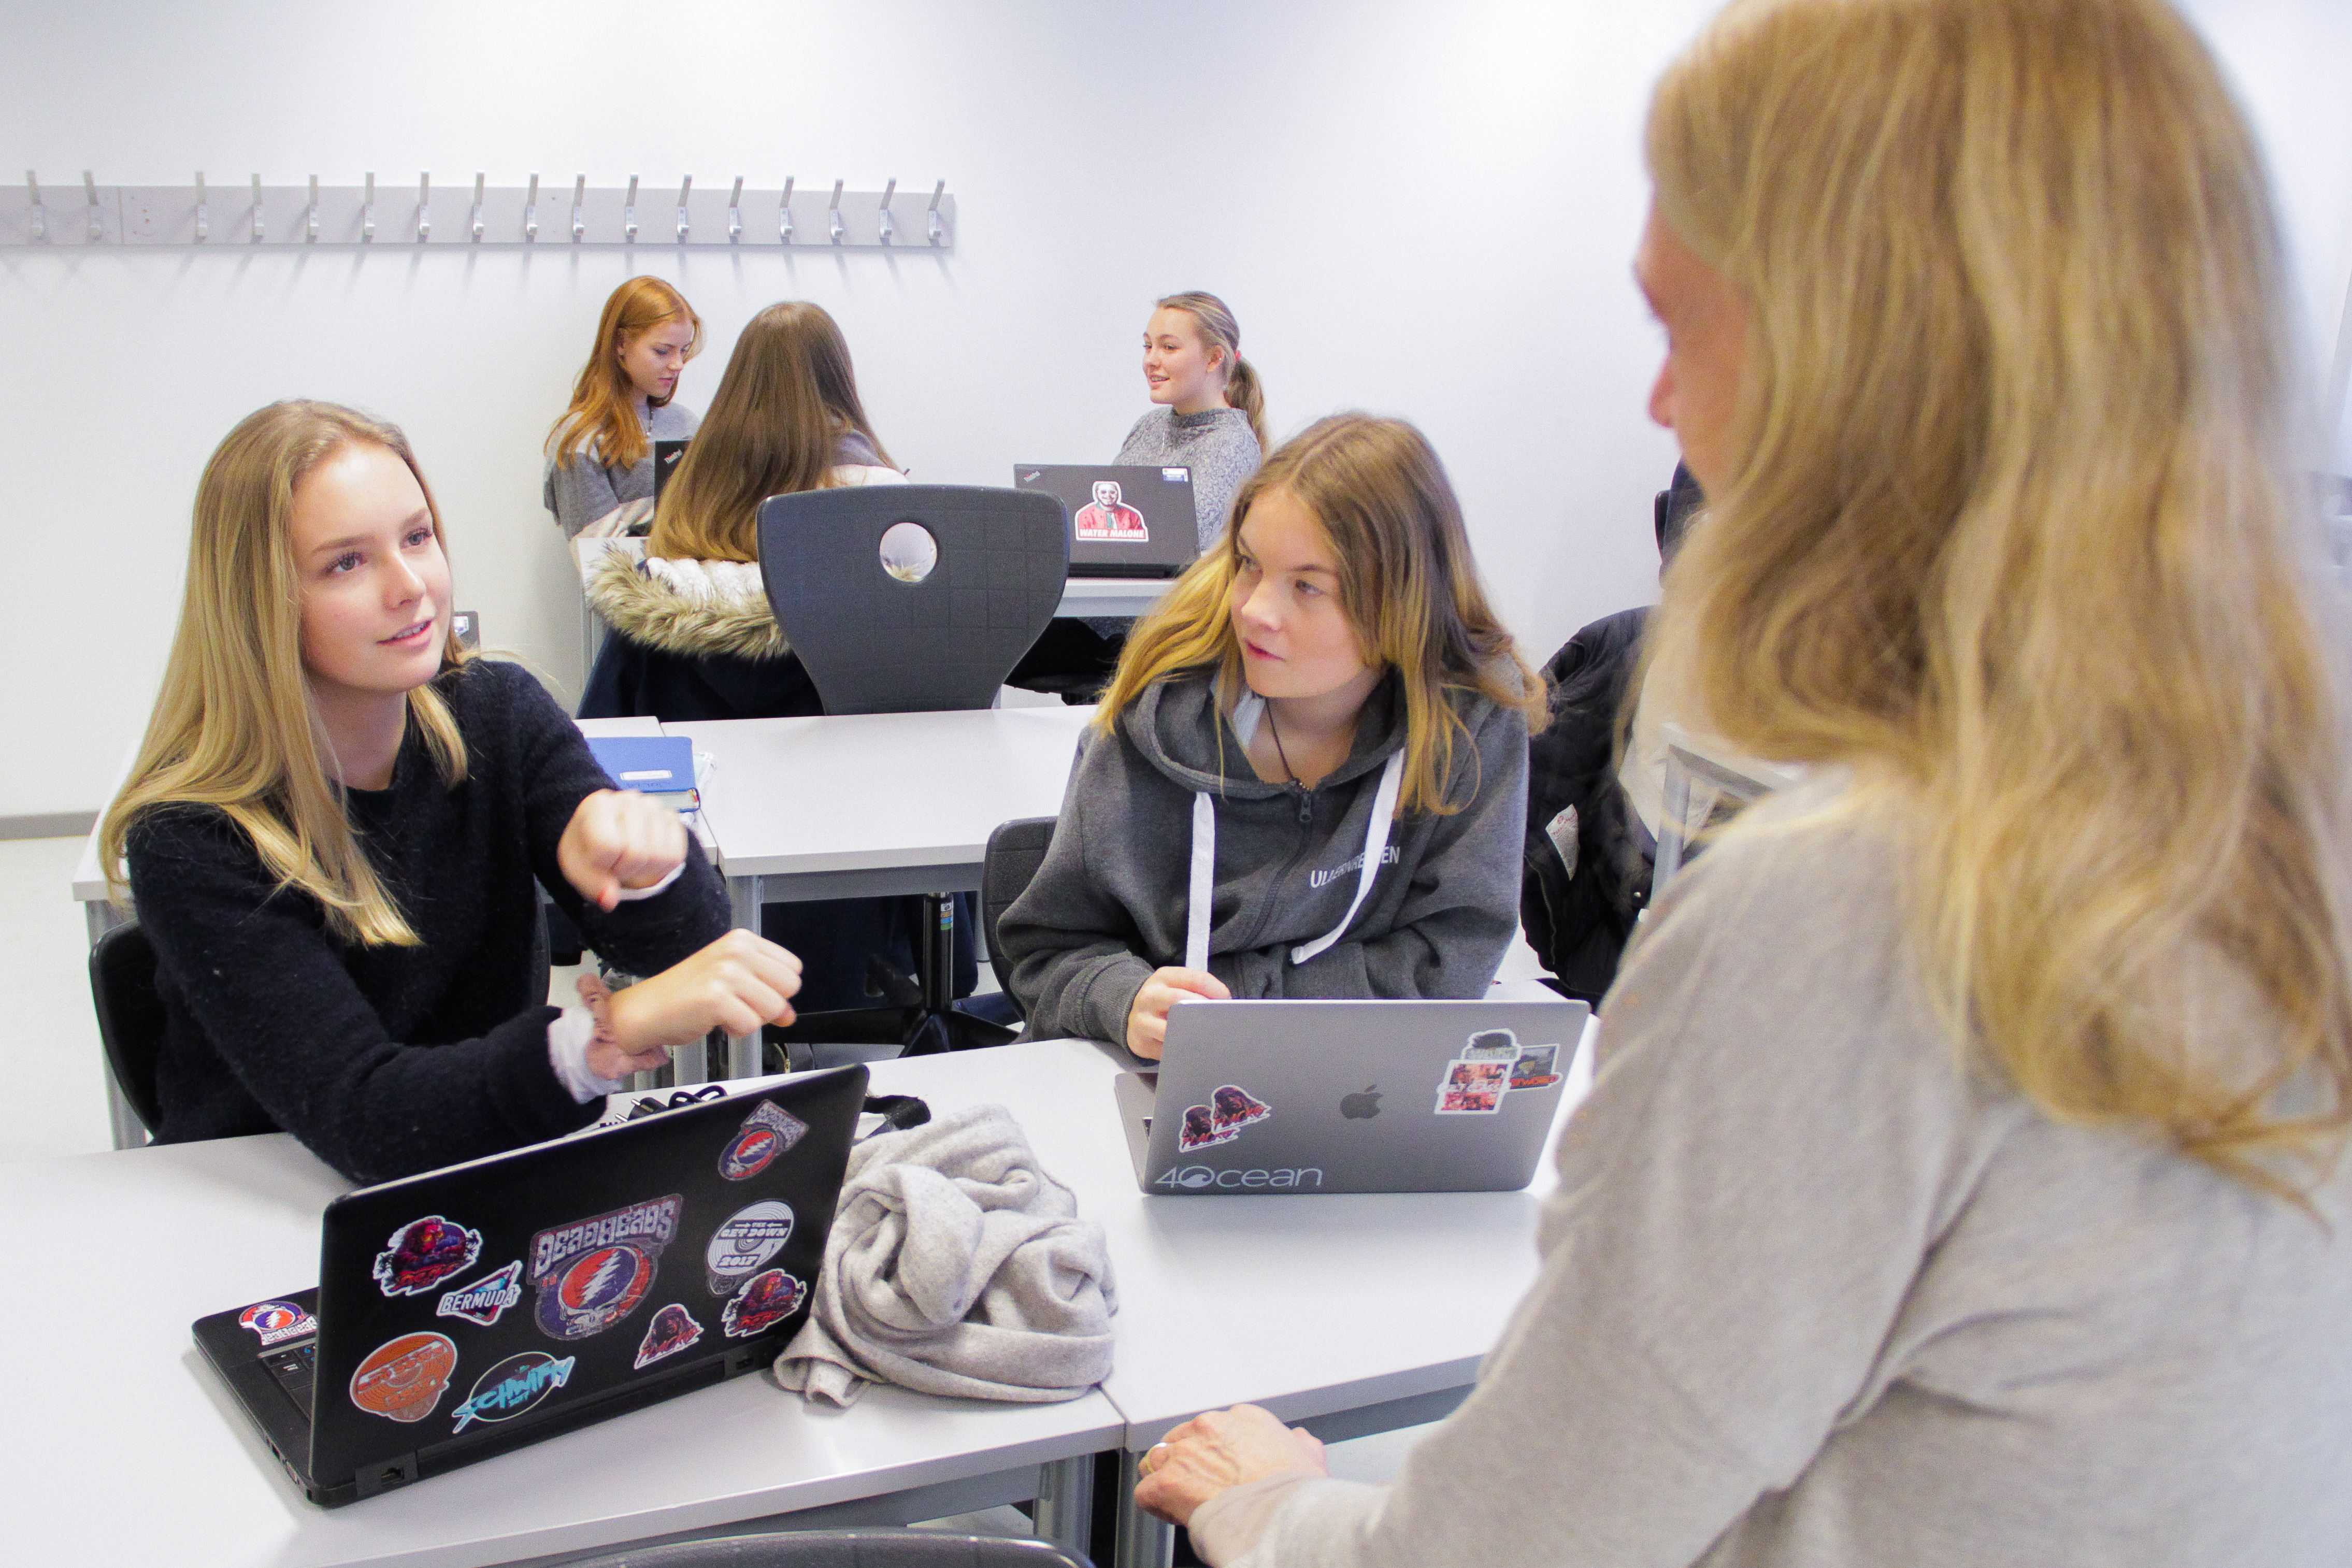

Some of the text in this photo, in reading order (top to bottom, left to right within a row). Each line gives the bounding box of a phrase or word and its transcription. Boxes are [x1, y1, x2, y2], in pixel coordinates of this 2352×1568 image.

[1080, 528, 1144, 538] WATER MALONE
[1154, 1166, 1323, 1188] 4Ocean
[534, 1200, 676, 1279] DEADHEADS
[720, 1228, 788, 1238] GET DOWN
[718, 1256, 758, 1266] 2017
[440, 1288, 515, 1313] BERMUDA
